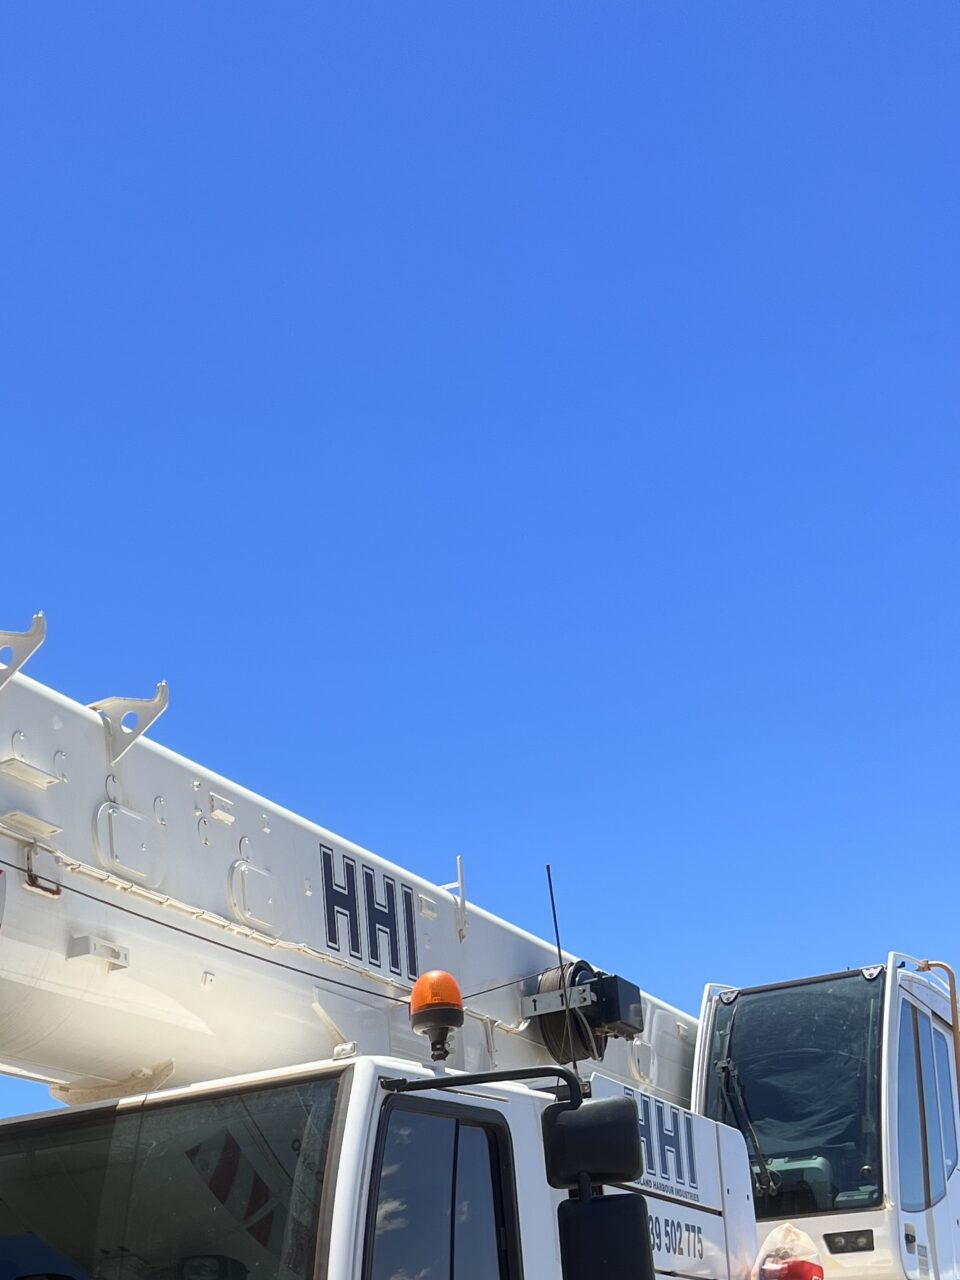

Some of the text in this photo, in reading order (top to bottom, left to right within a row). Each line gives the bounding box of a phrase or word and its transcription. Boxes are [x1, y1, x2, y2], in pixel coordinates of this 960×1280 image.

[319, 843, 419, 982] HHI
[653, 1181, 675, 1194] HARBOUR
[675, 1187, 700, 1202] INDUSTRIES
[648, 1215, 704, 1260] 39 502 775
